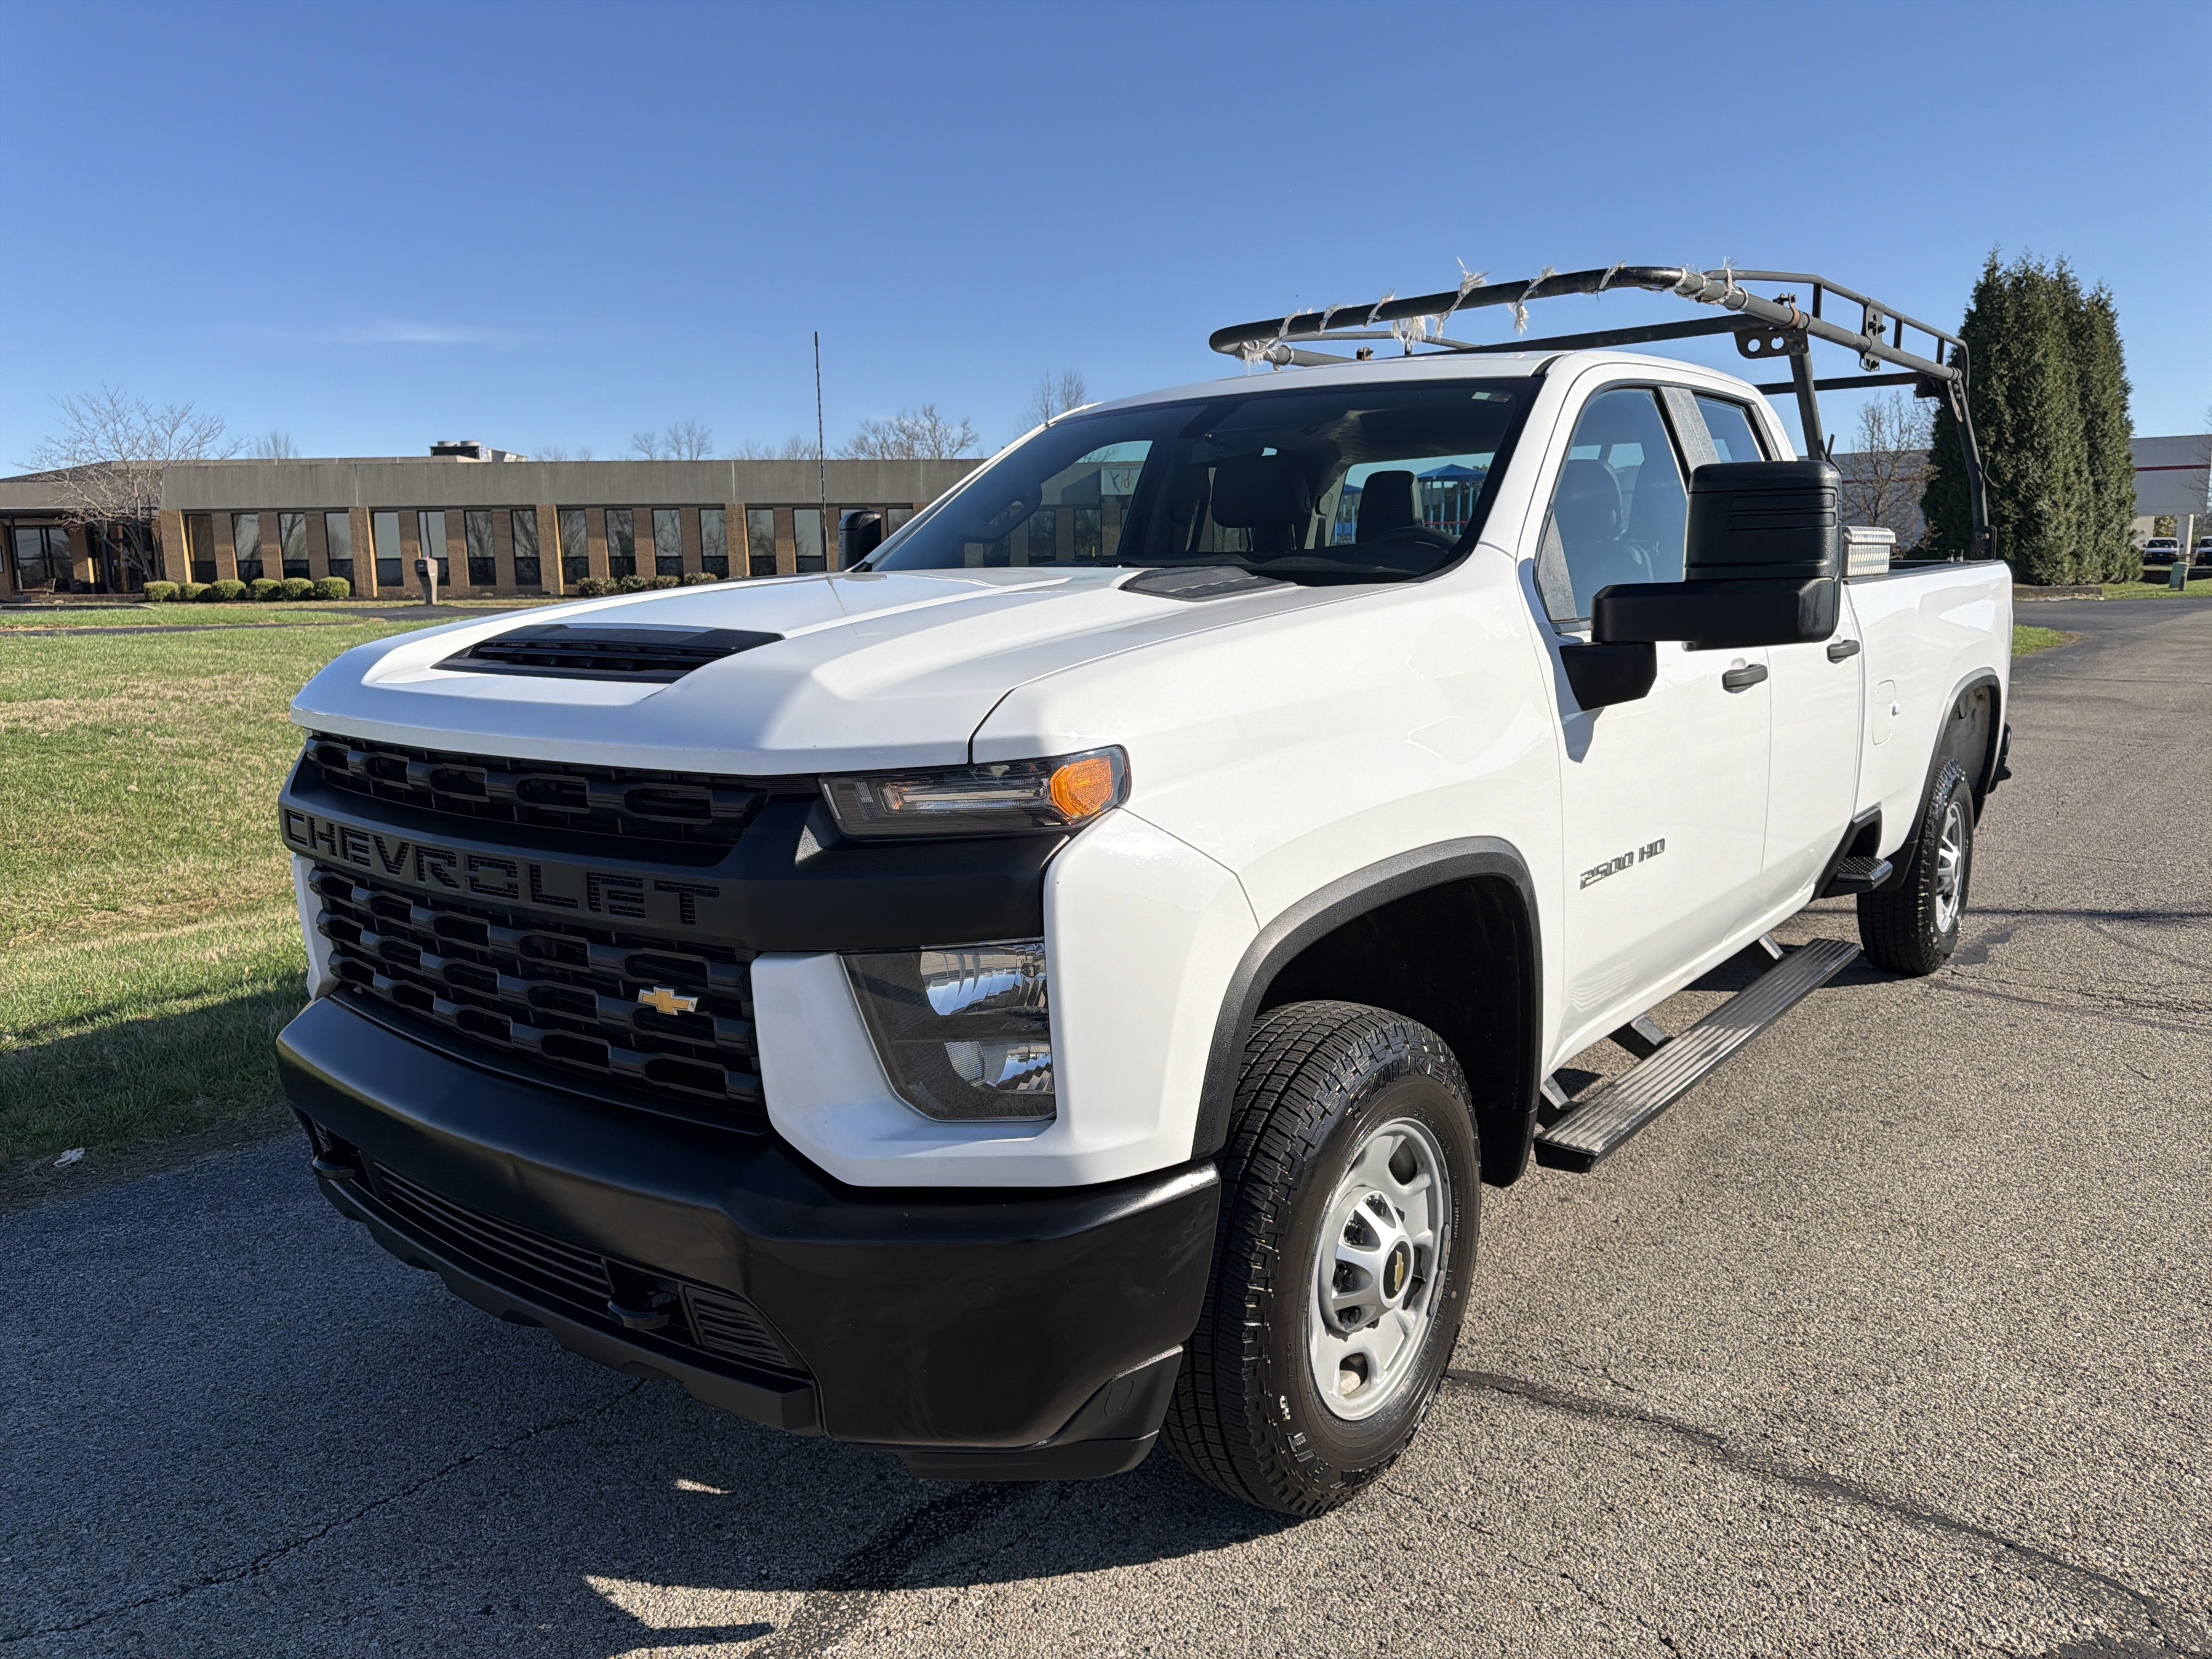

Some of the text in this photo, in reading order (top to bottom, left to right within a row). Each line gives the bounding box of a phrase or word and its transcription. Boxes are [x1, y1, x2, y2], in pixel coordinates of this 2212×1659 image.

[285, 808, 720, 925] CHEVROLET
[1579, 838, 1666, 890] 2500 HD
